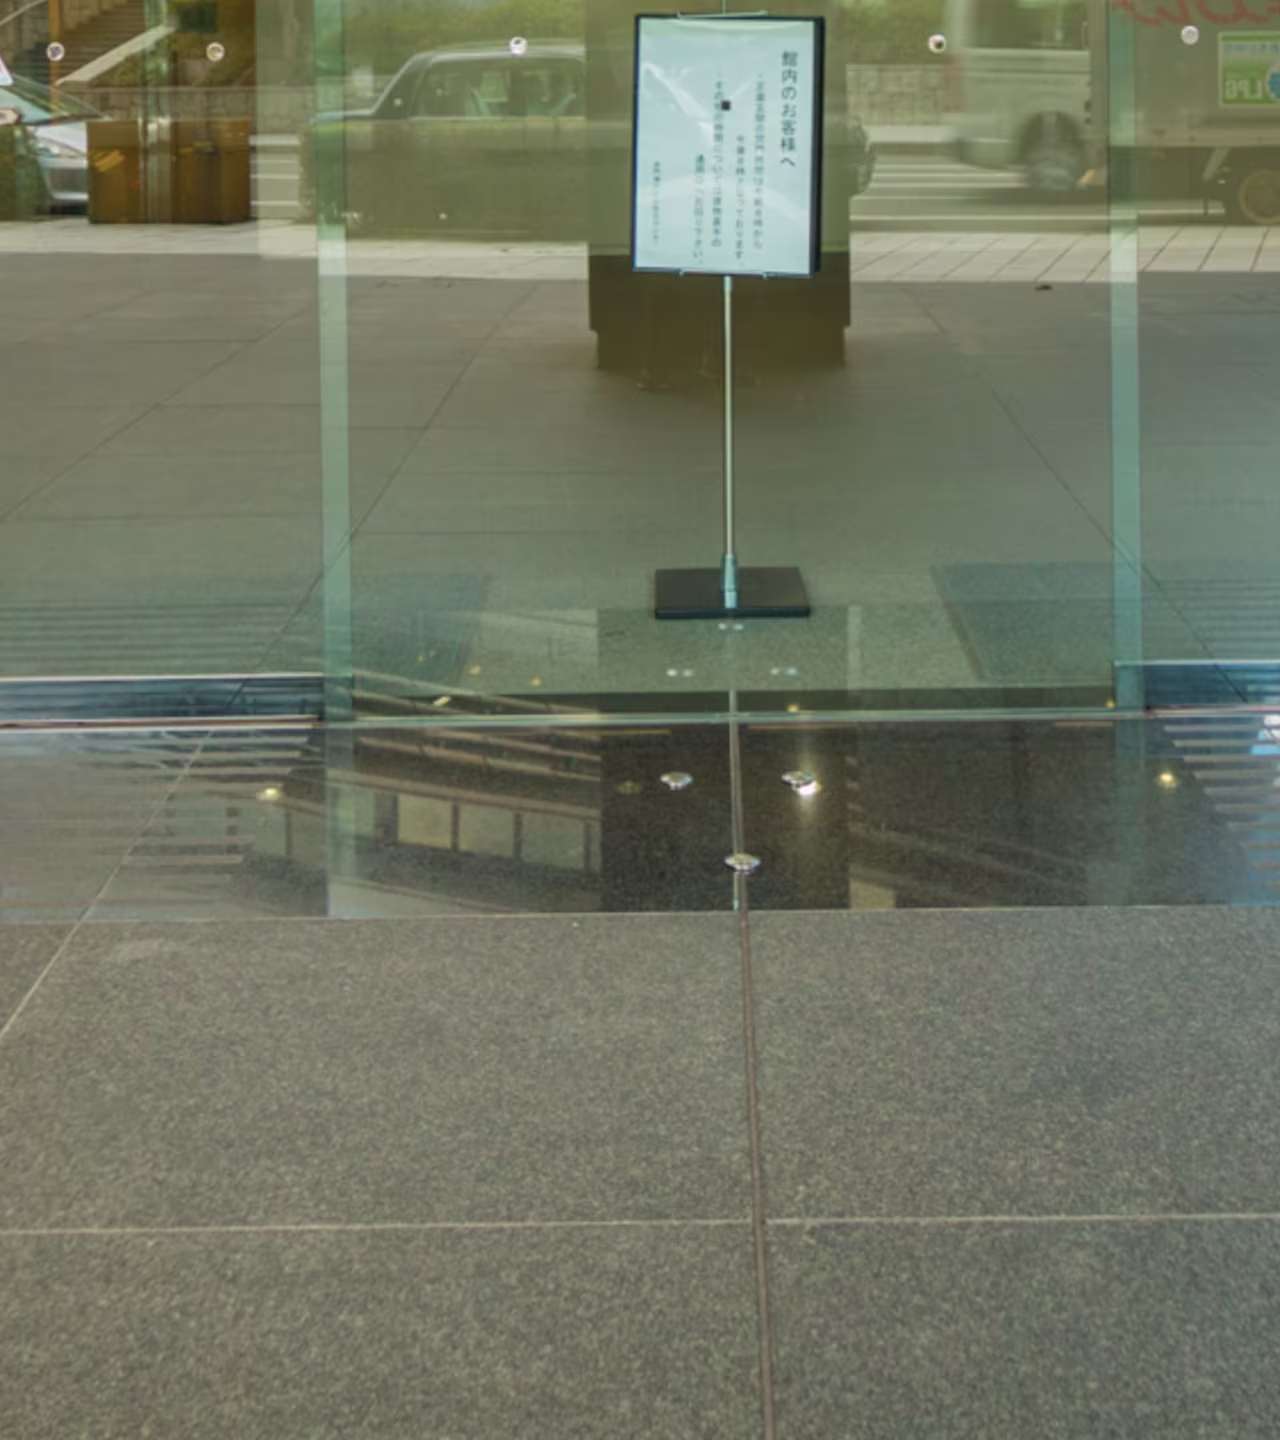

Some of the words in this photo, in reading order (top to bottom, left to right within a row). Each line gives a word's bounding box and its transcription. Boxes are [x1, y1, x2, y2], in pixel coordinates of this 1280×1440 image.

[780, 50, 798, 168] 館内のお客様へ
